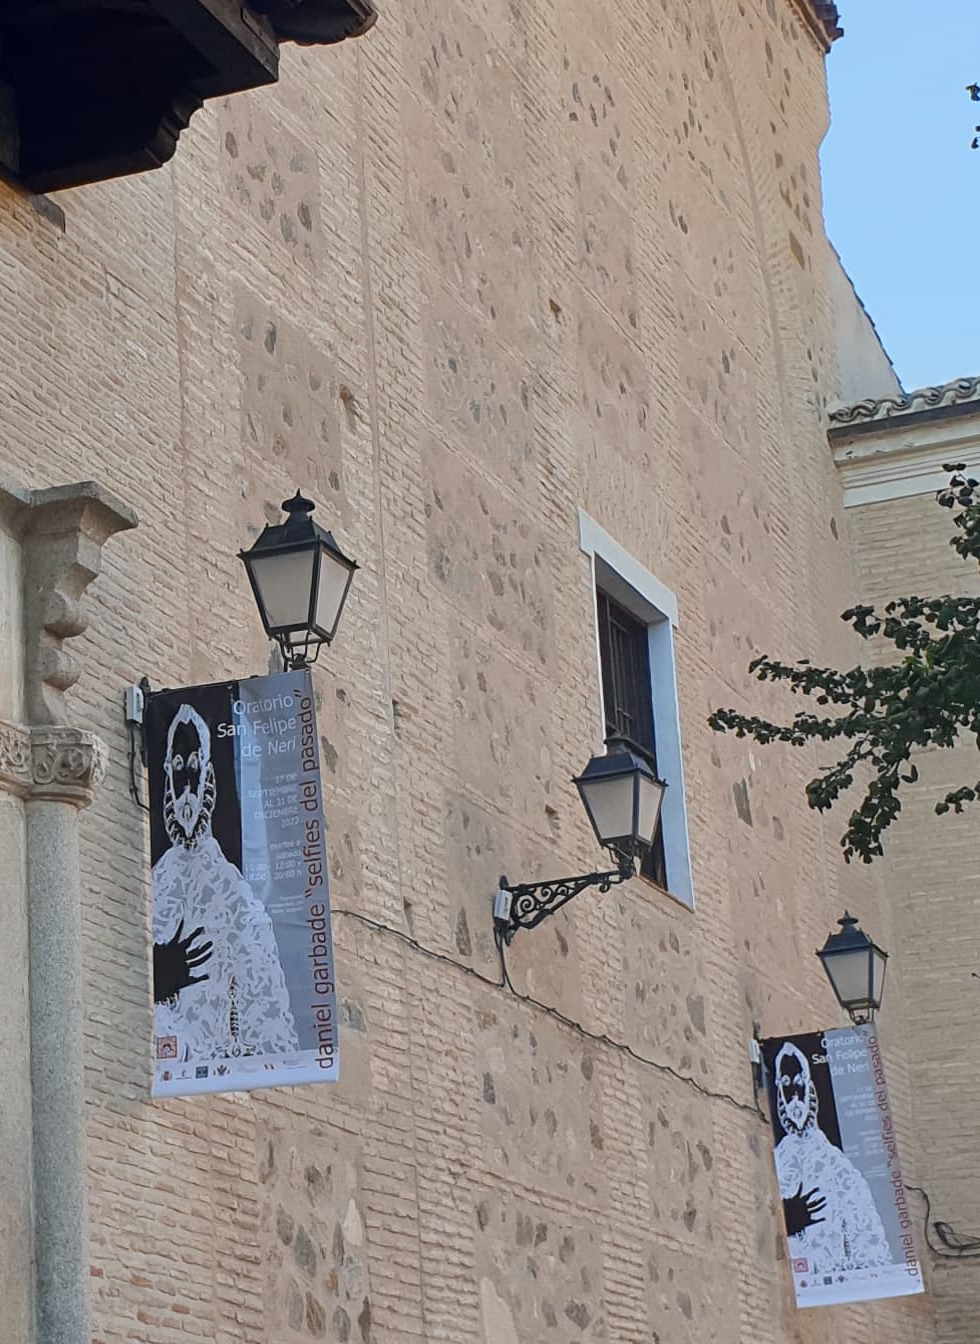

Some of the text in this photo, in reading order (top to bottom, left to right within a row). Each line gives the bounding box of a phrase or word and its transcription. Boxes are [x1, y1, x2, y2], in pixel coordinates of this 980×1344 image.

[233, 694, 294, 715] Oratorio
[217, 717, 297, 738] San Felipe
[241, 743, 262, 757] de
[299, 779, 318, 811] del
[306, 904, 335, 995] garbade
[311, 1004, 334, 1069] daniel
[812, 1047, 868, 1065] San Felipe
[875, 1090, 888, 1111] del
[889, 1171, 913, 1229] garbade
[900, 1234, 918, 1276] daniel
